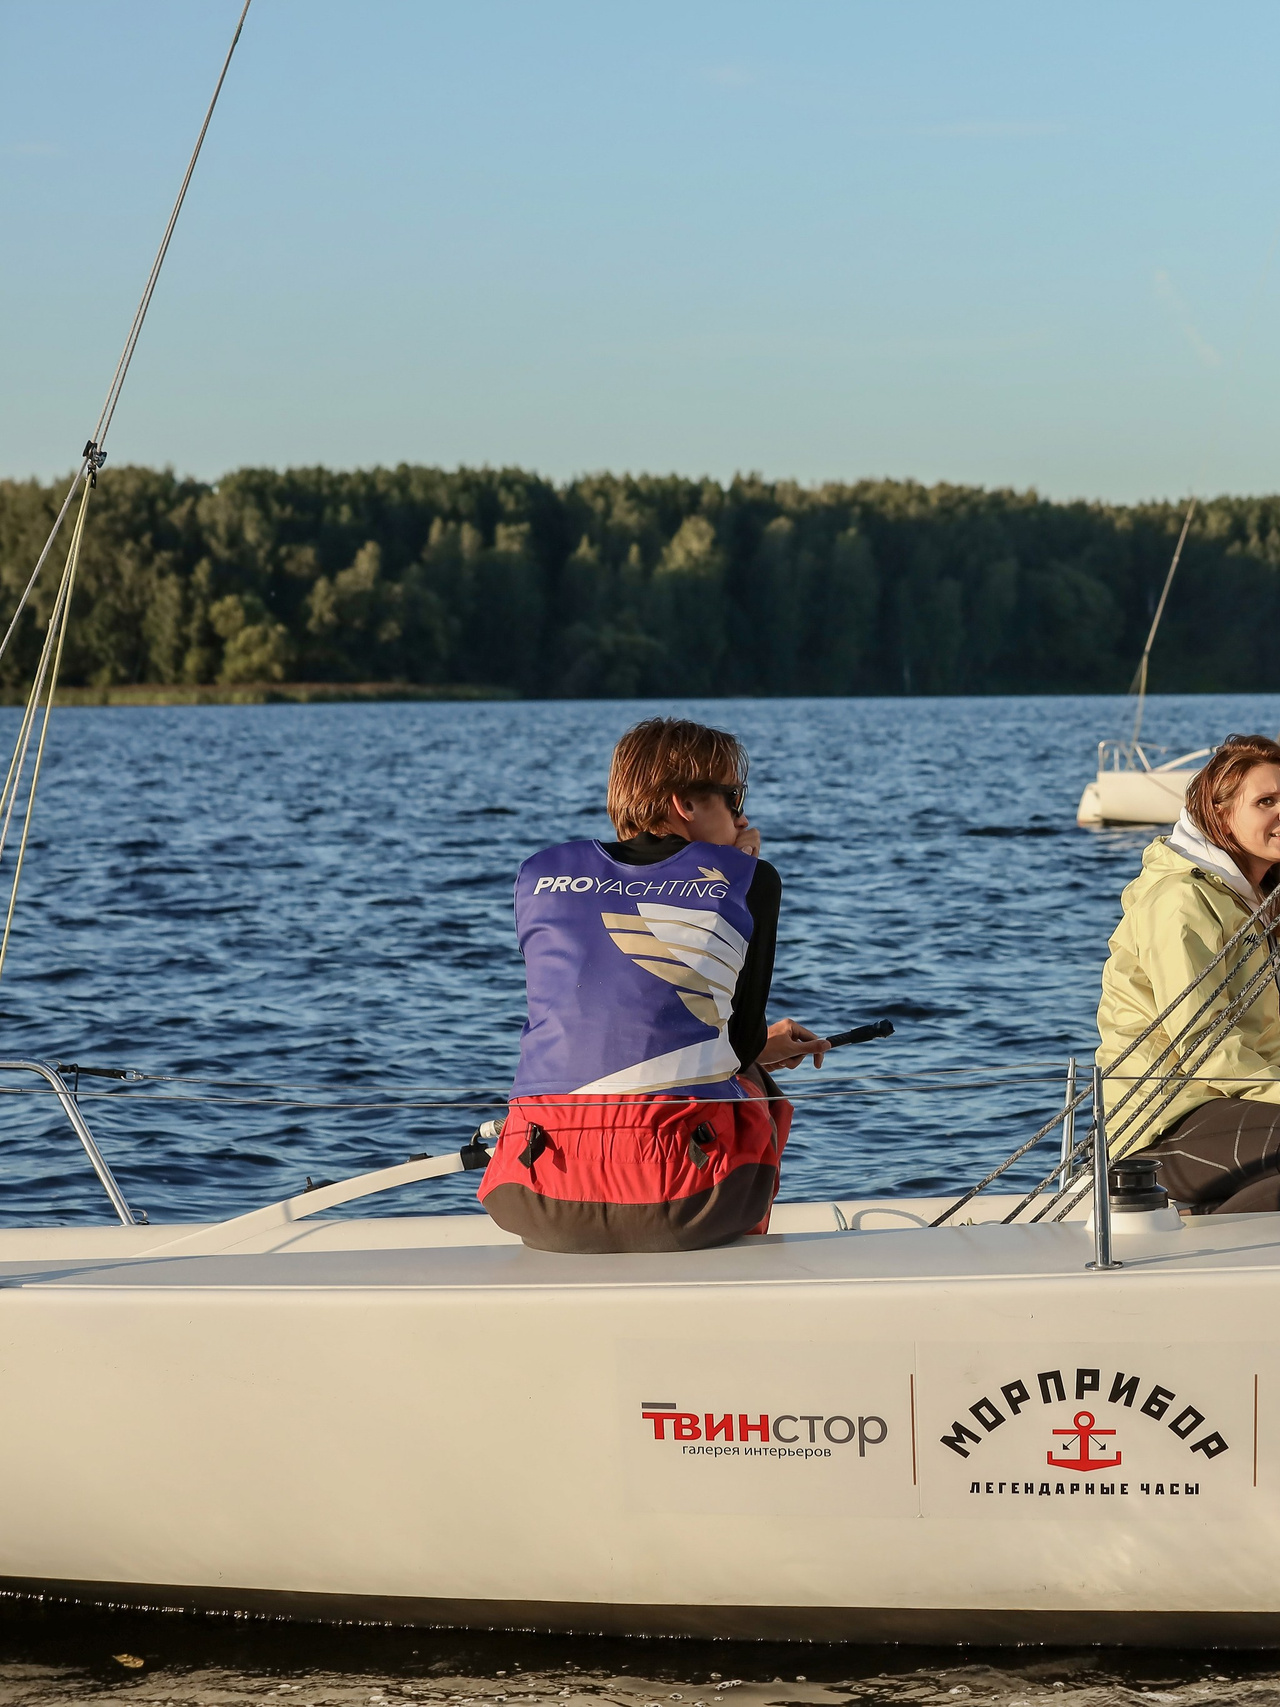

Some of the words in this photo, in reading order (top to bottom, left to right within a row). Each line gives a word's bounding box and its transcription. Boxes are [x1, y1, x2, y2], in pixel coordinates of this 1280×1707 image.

[533, 876, 730, 899] PROYACHTING
[939, 1368, 1229, 1459] МОРПРИБОР
[682, 1444, 740, 1458] галерея
[744, 1446, 832, 1459] интерьеров
[969, 1481, 1129, 1496] ЛЕГЕНДАРНЫЕ
[1140, 1483, 1200, 1495] ЧАСЫ
